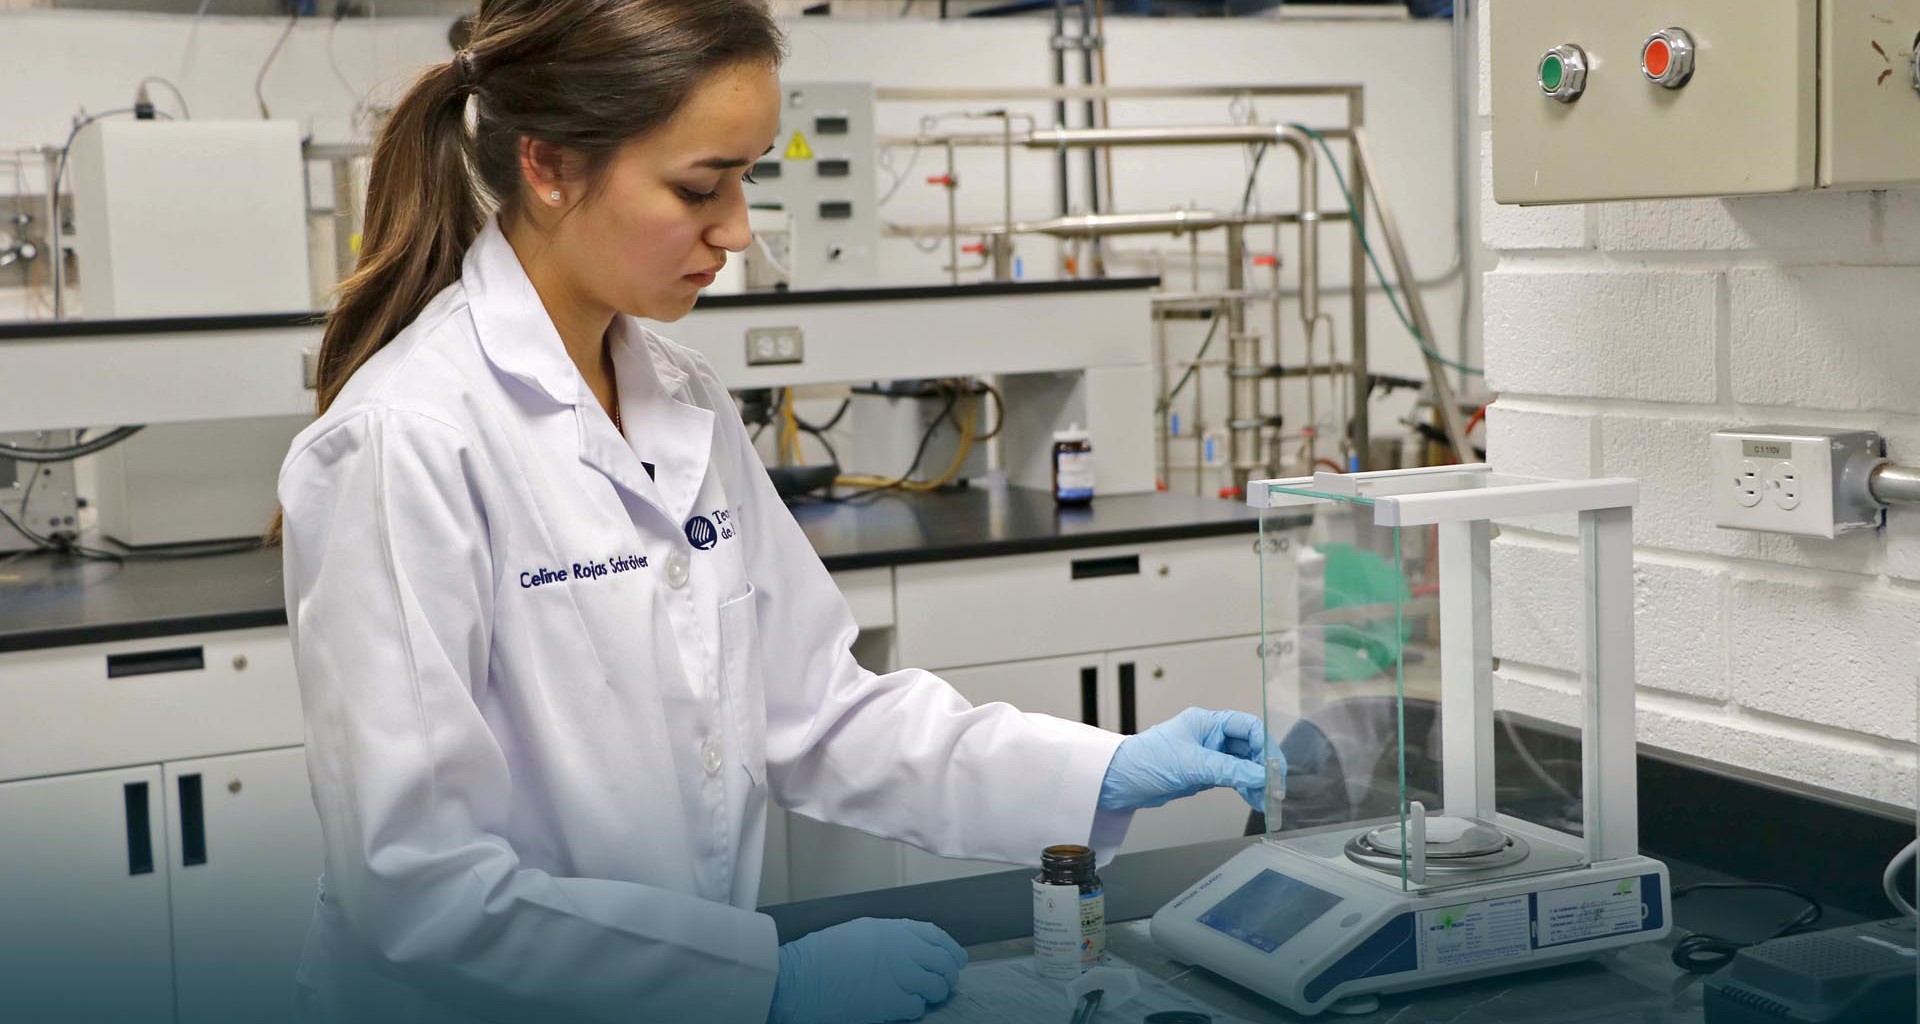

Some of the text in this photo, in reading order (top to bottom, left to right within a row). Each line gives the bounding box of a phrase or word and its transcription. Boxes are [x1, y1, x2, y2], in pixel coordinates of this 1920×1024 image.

[721, 527, 733, 540] de
[520, 555, 648, 588] Celine Rojas Schröter
